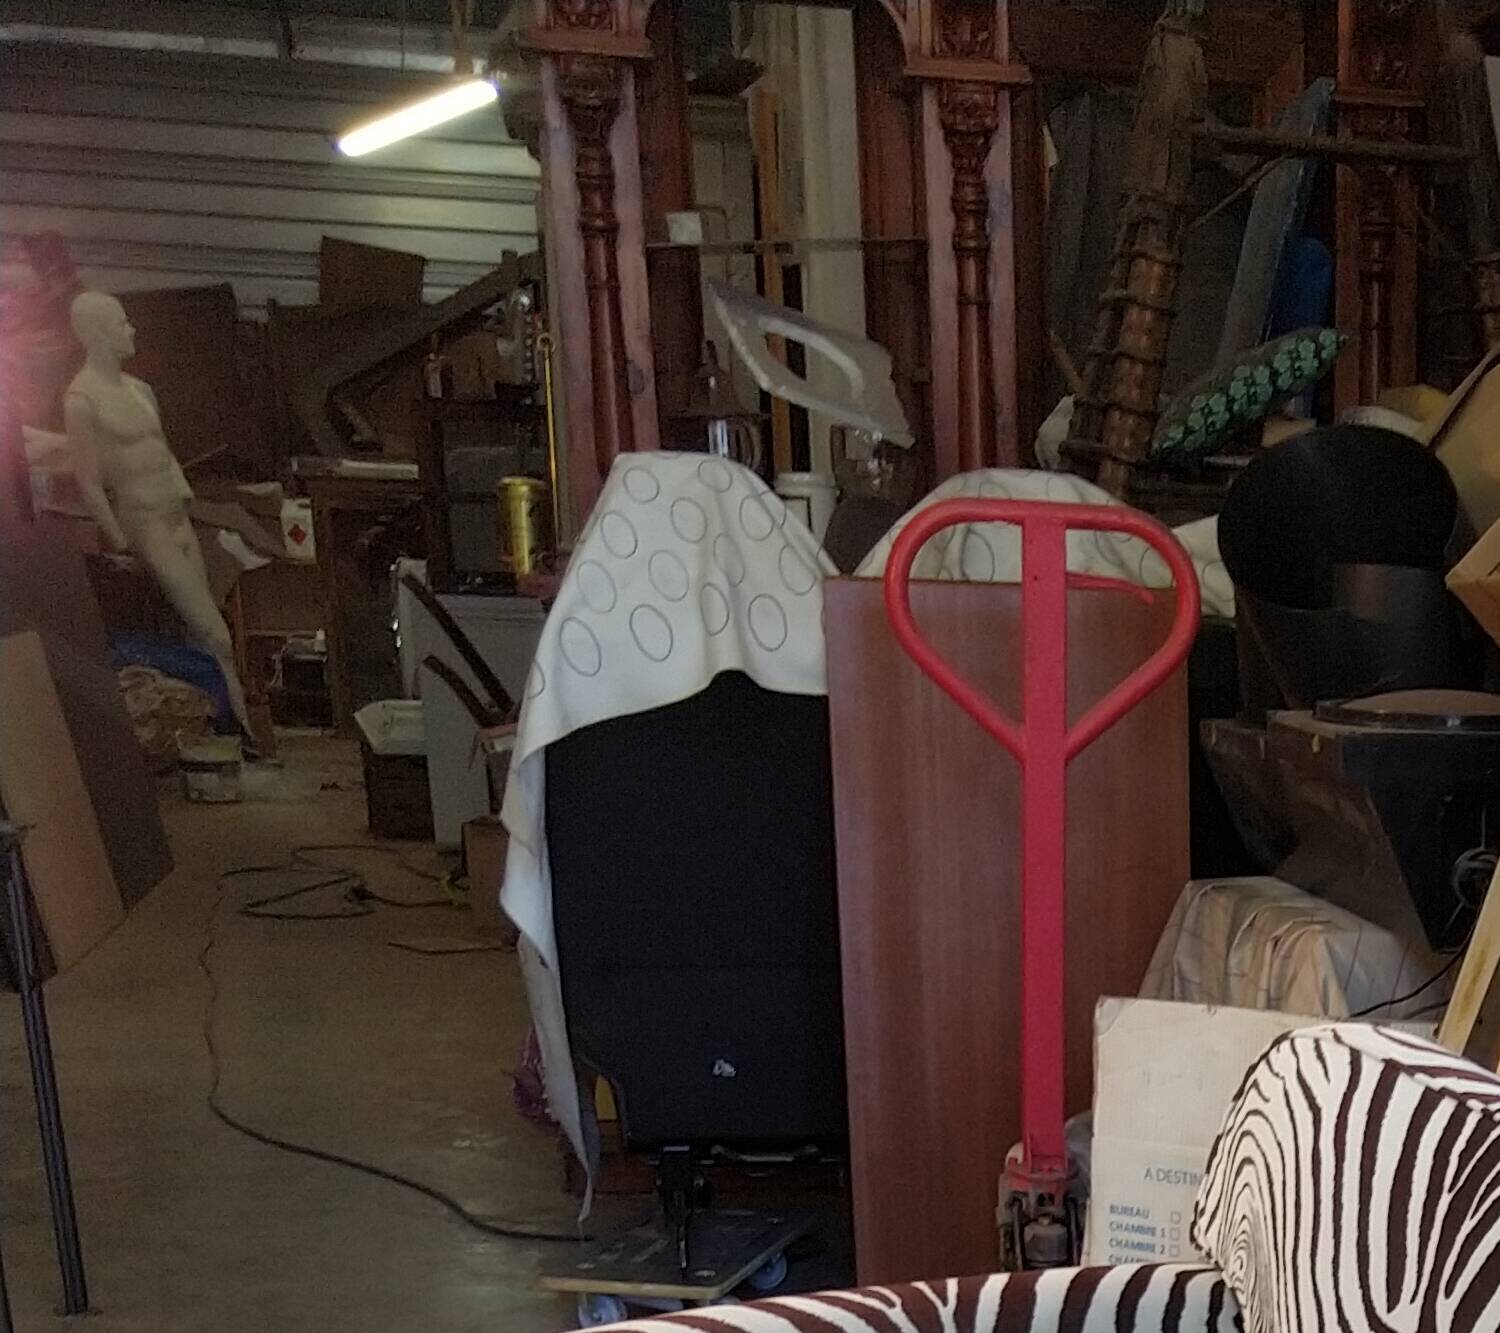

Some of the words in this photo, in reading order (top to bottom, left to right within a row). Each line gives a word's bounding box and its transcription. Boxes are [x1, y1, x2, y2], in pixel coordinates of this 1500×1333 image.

[1110, 1204, 1150, 1219] BUREAU
[1109, 1221, 1156, 1237] CHAMBRE
[1160, 1227, 1166, 1238] 1
[1109, 1238, 1156, 1254] CHAMBRE
[1159, 1244, 1166, 1255] 2
